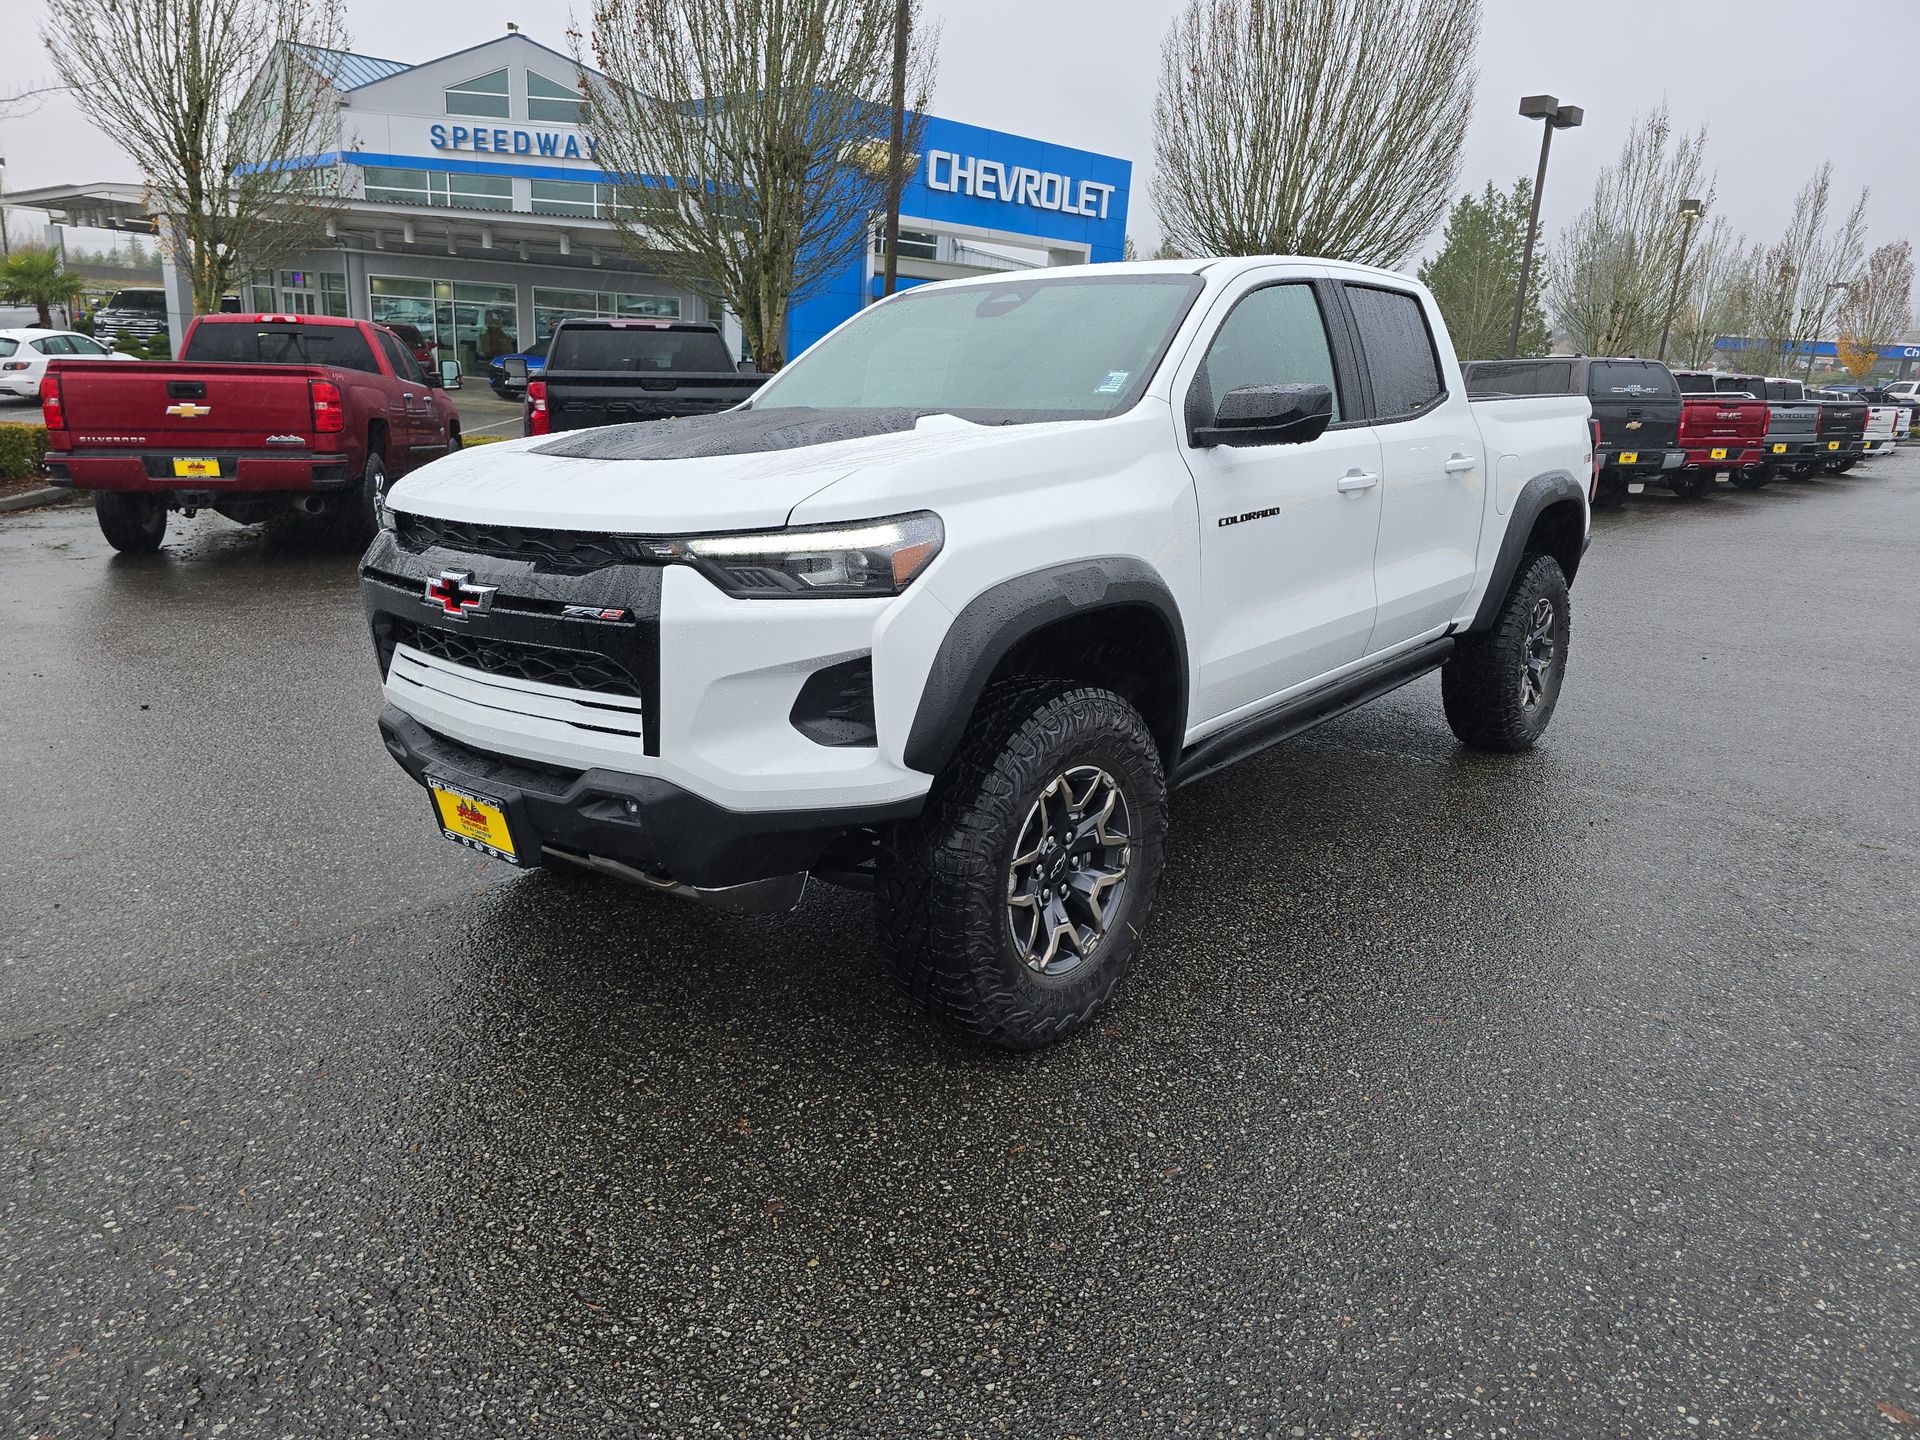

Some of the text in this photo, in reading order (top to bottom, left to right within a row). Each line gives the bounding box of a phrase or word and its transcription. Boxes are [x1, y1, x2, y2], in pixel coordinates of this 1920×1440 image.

[430, 124, 600, 160] SPEEDWAY
[927, 149, 1115, 219] CHEVROLET
[1218, 506, 1281, 528] COLORADO
[561, 604, 625, 621] ZR2
